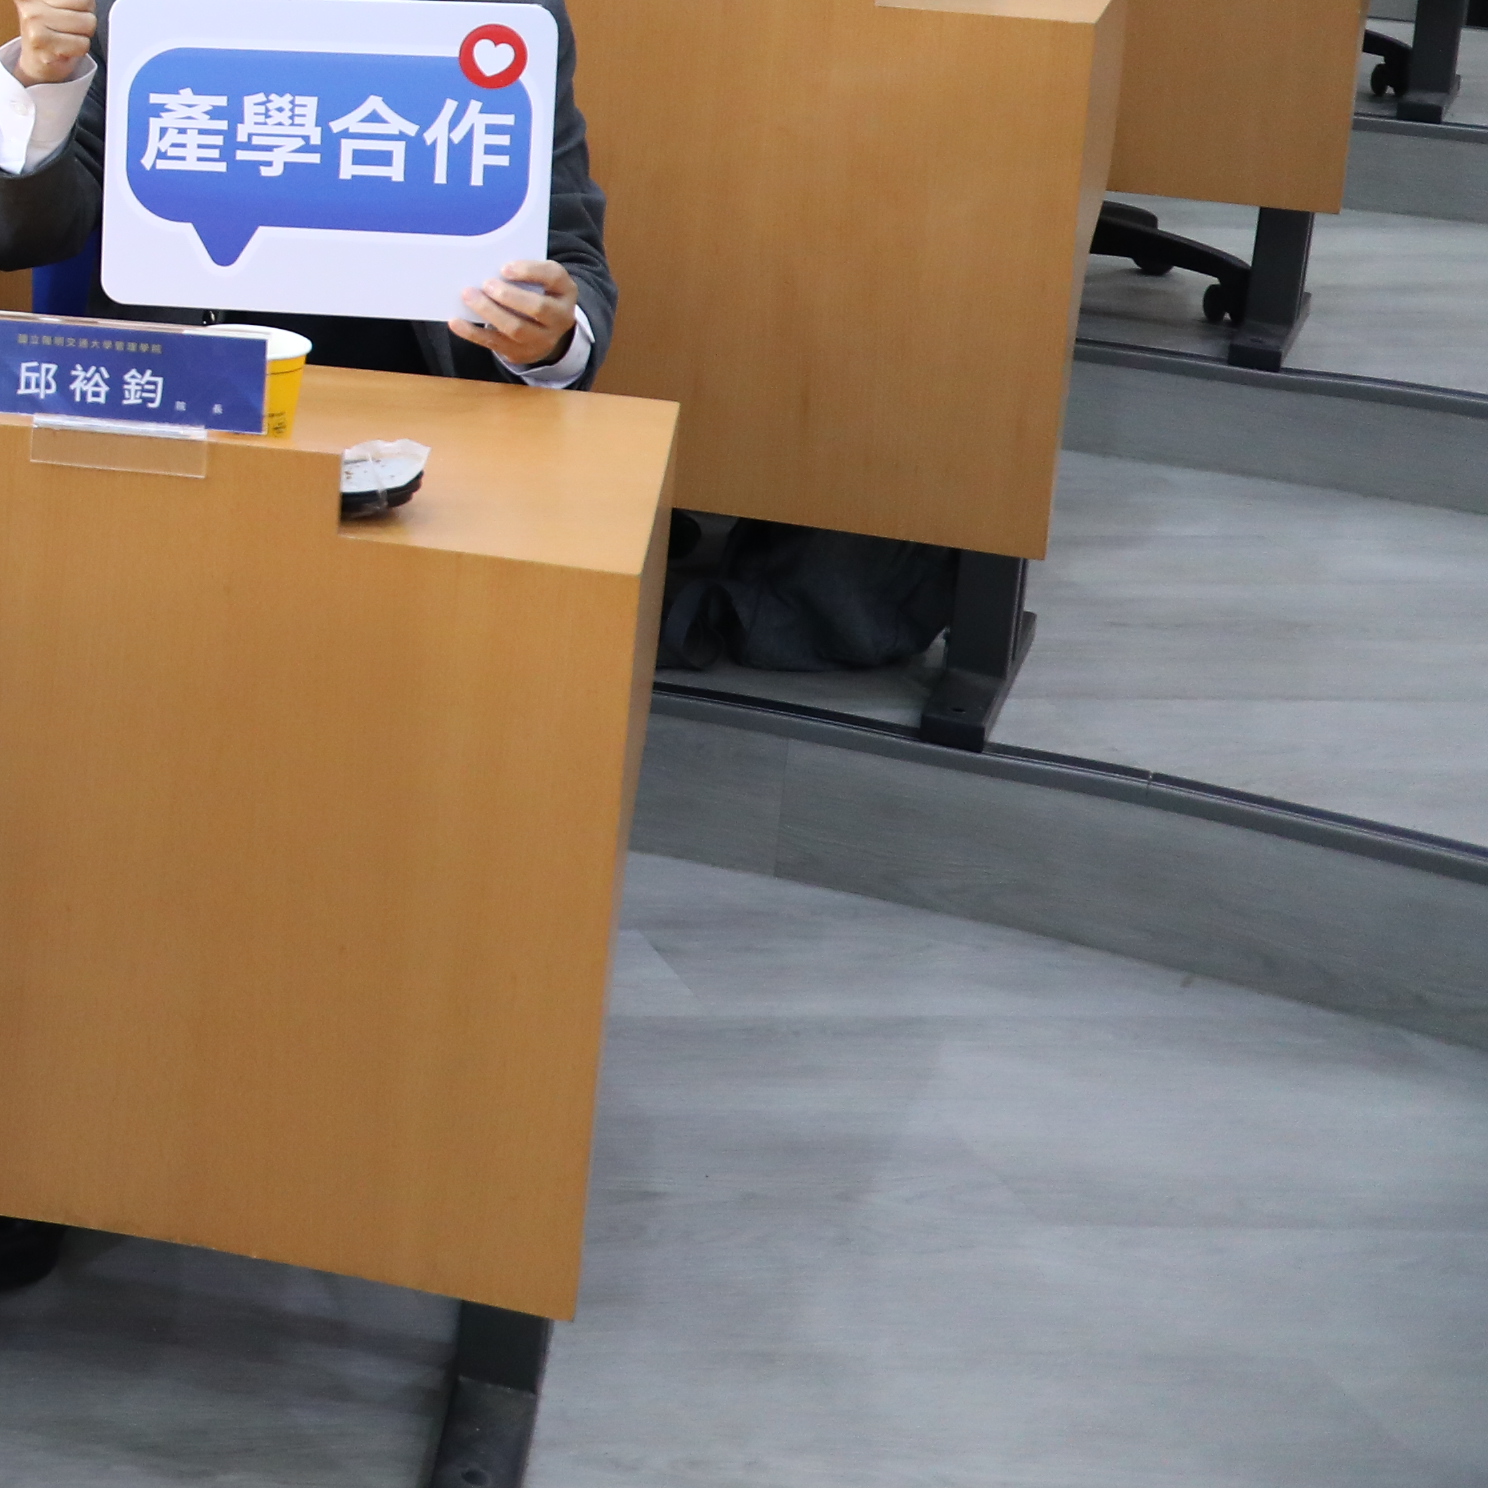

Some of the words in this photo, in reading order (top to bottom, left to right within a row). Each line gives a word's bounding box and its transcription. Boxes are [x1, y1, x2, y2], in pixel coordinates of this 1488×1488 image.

[141, 87, 515, 187] 產學合作
[17, 361, 164, 408] 邱裕鈞
